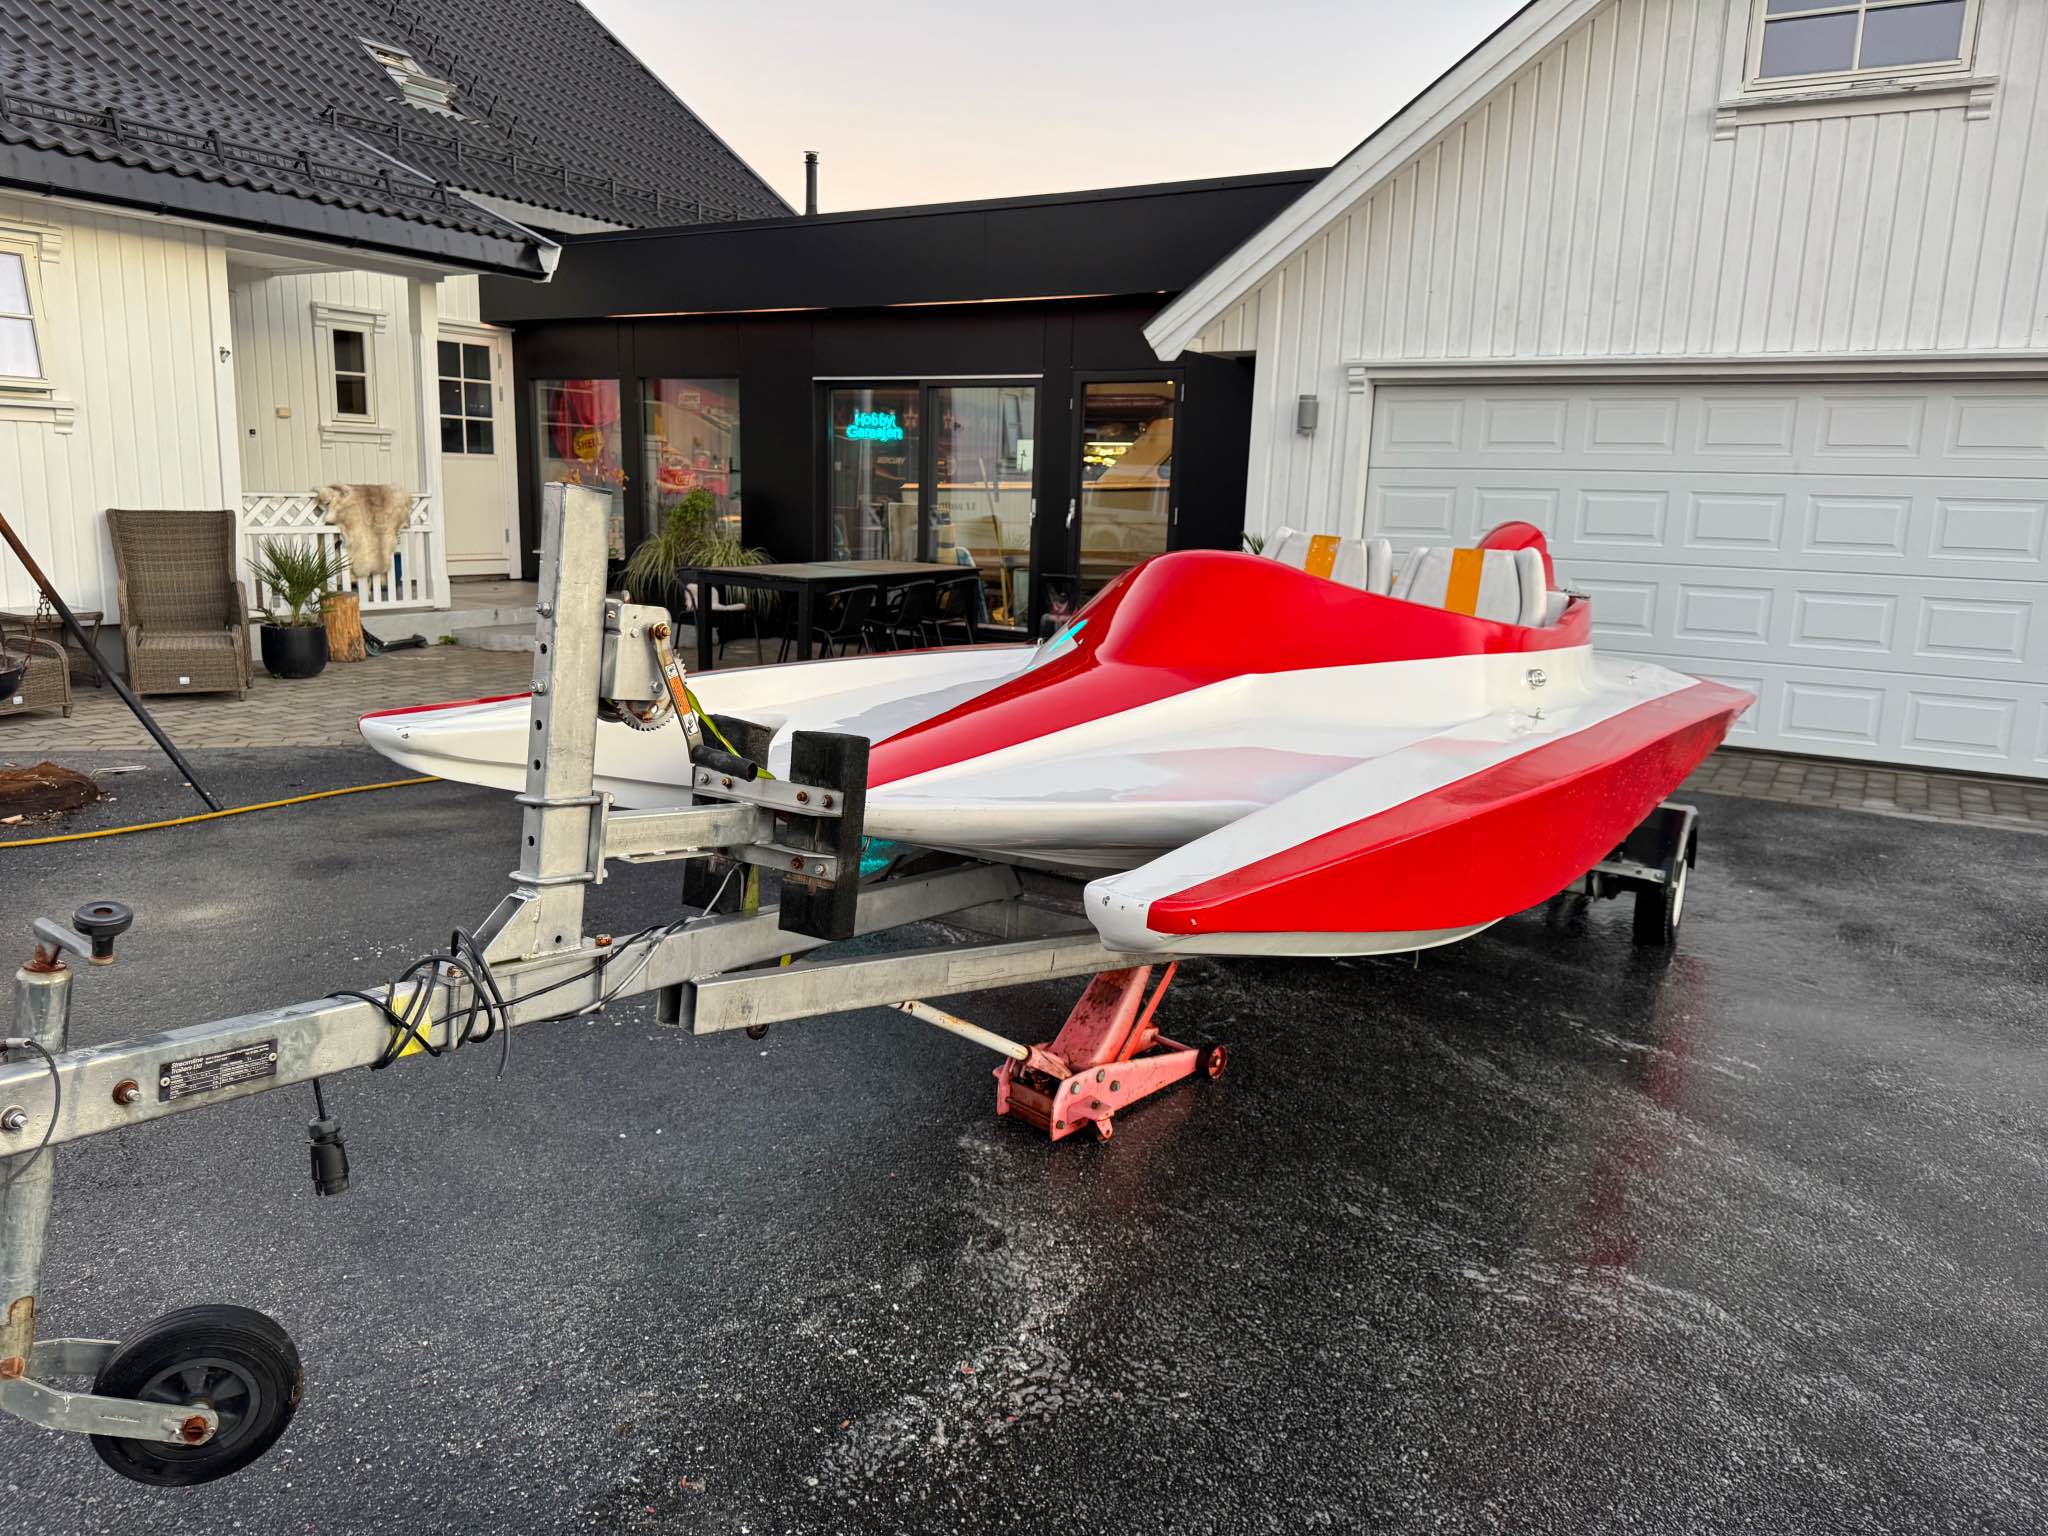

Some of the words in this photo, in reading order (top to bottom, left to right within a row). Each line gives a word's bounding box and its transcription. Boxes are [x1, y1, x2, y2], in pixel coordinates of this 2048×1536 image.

[854, 409, 896, 428] Hobby
[171, 1057, 204, 1069] Streamline
[171, 1066, 193, 1075] Trailers
